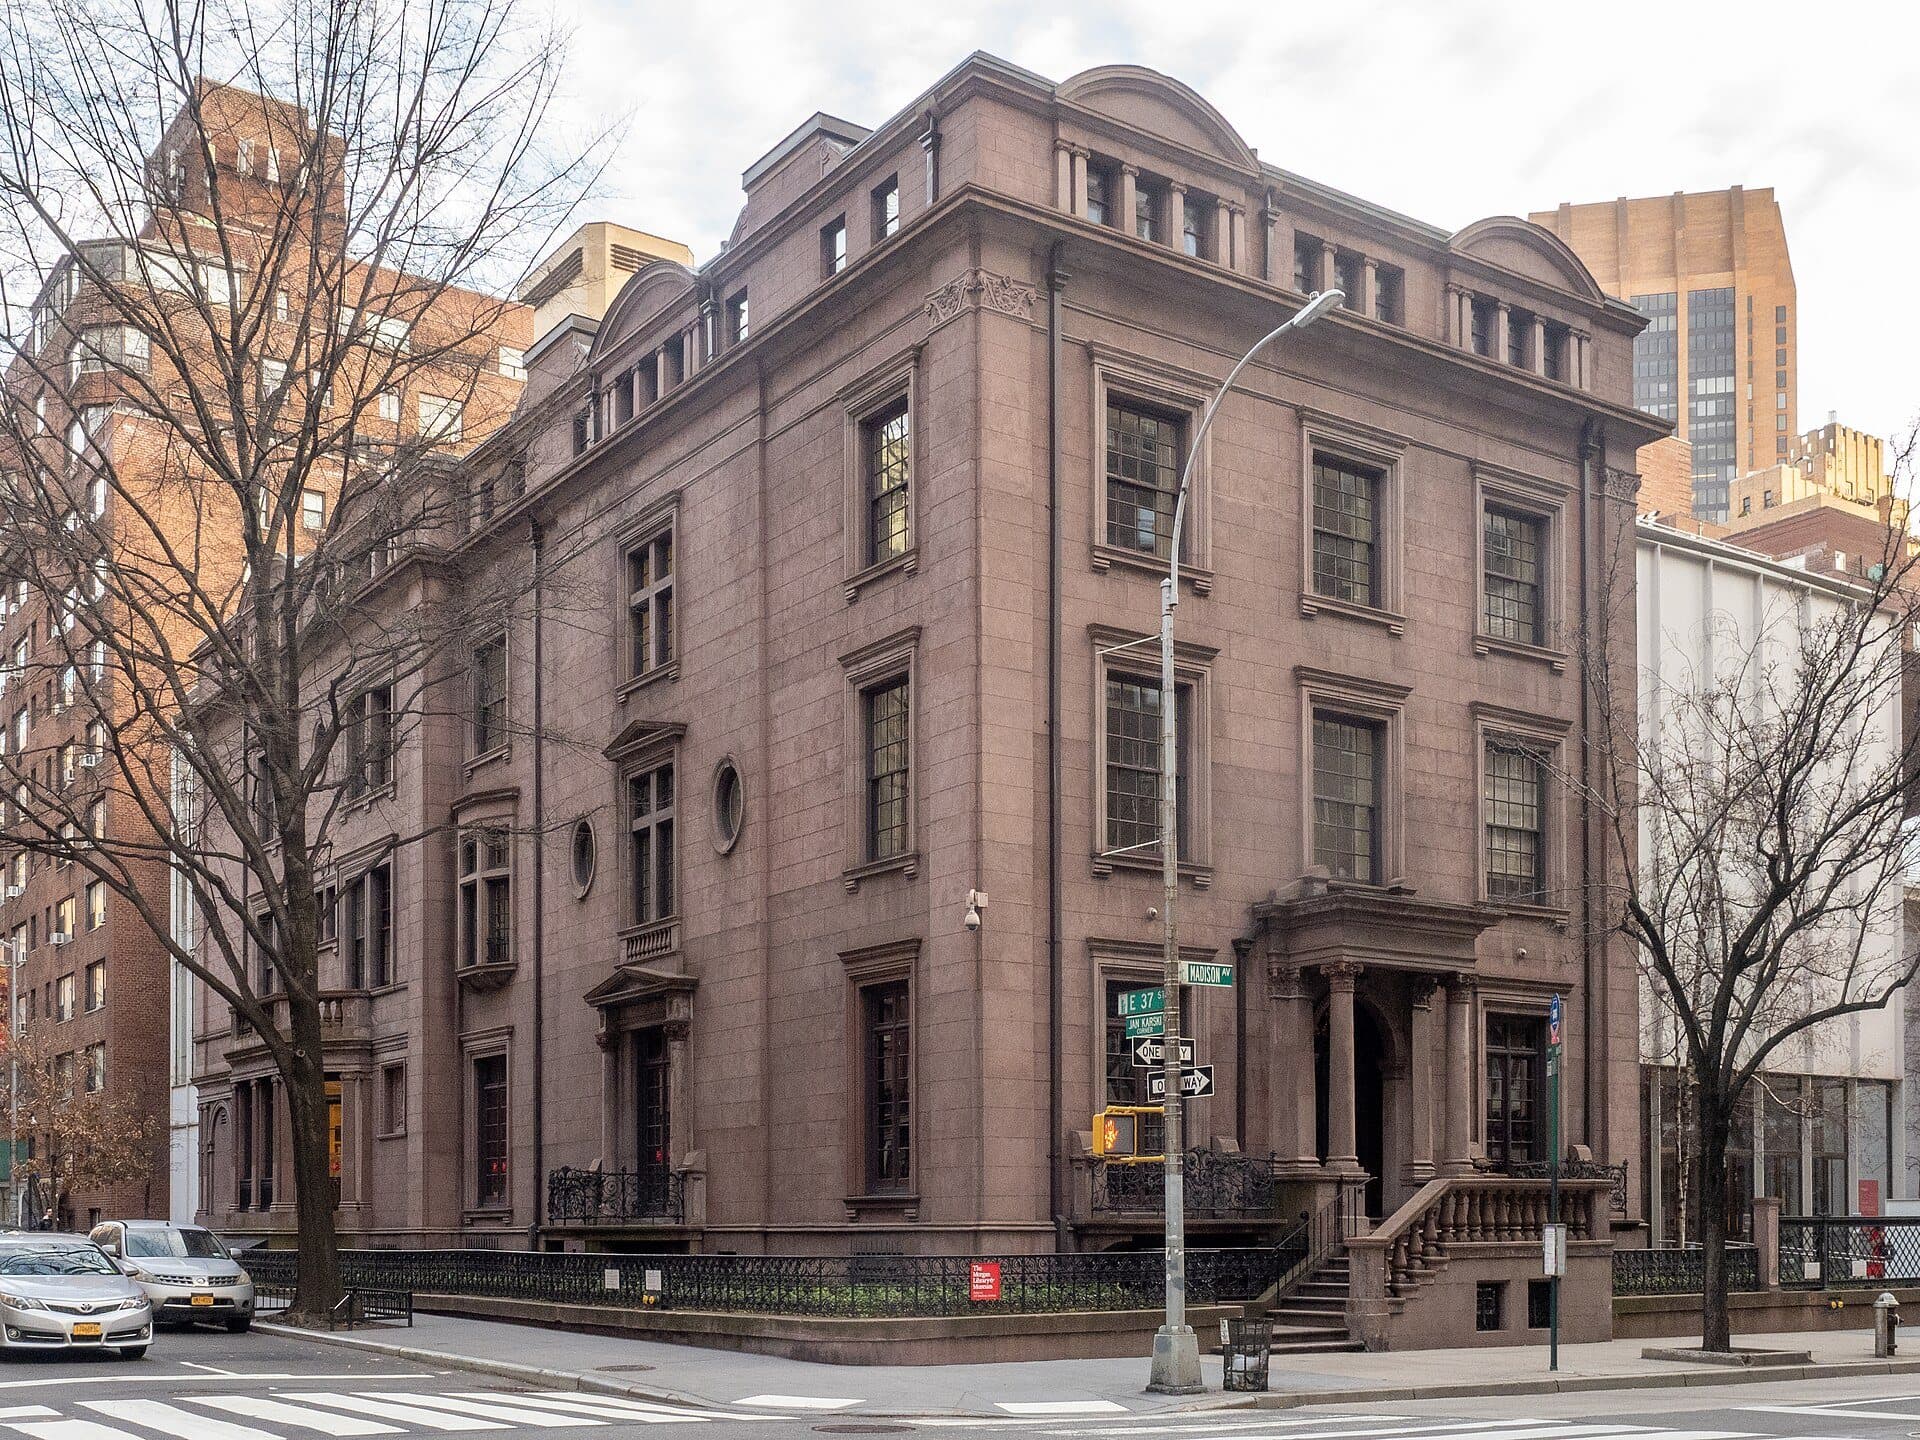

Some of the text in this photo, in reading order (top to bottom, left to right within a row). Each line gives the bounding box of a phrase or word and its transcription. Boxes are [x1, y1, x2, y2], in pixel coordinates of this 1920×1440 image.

[1190, 965, 1231, 983] MADISON AV
[1130, 994, 1136, 1011] E
[1141, 992, 1154, 1009] 37
[1128, 1016, 1162, 1030] JAN KARSKI
[1136, 1026, 1153, 1035] CORNER
[1142, 1046, 1160, 1057] ONE
[1183, 1076, 1203, 1089] WAY
